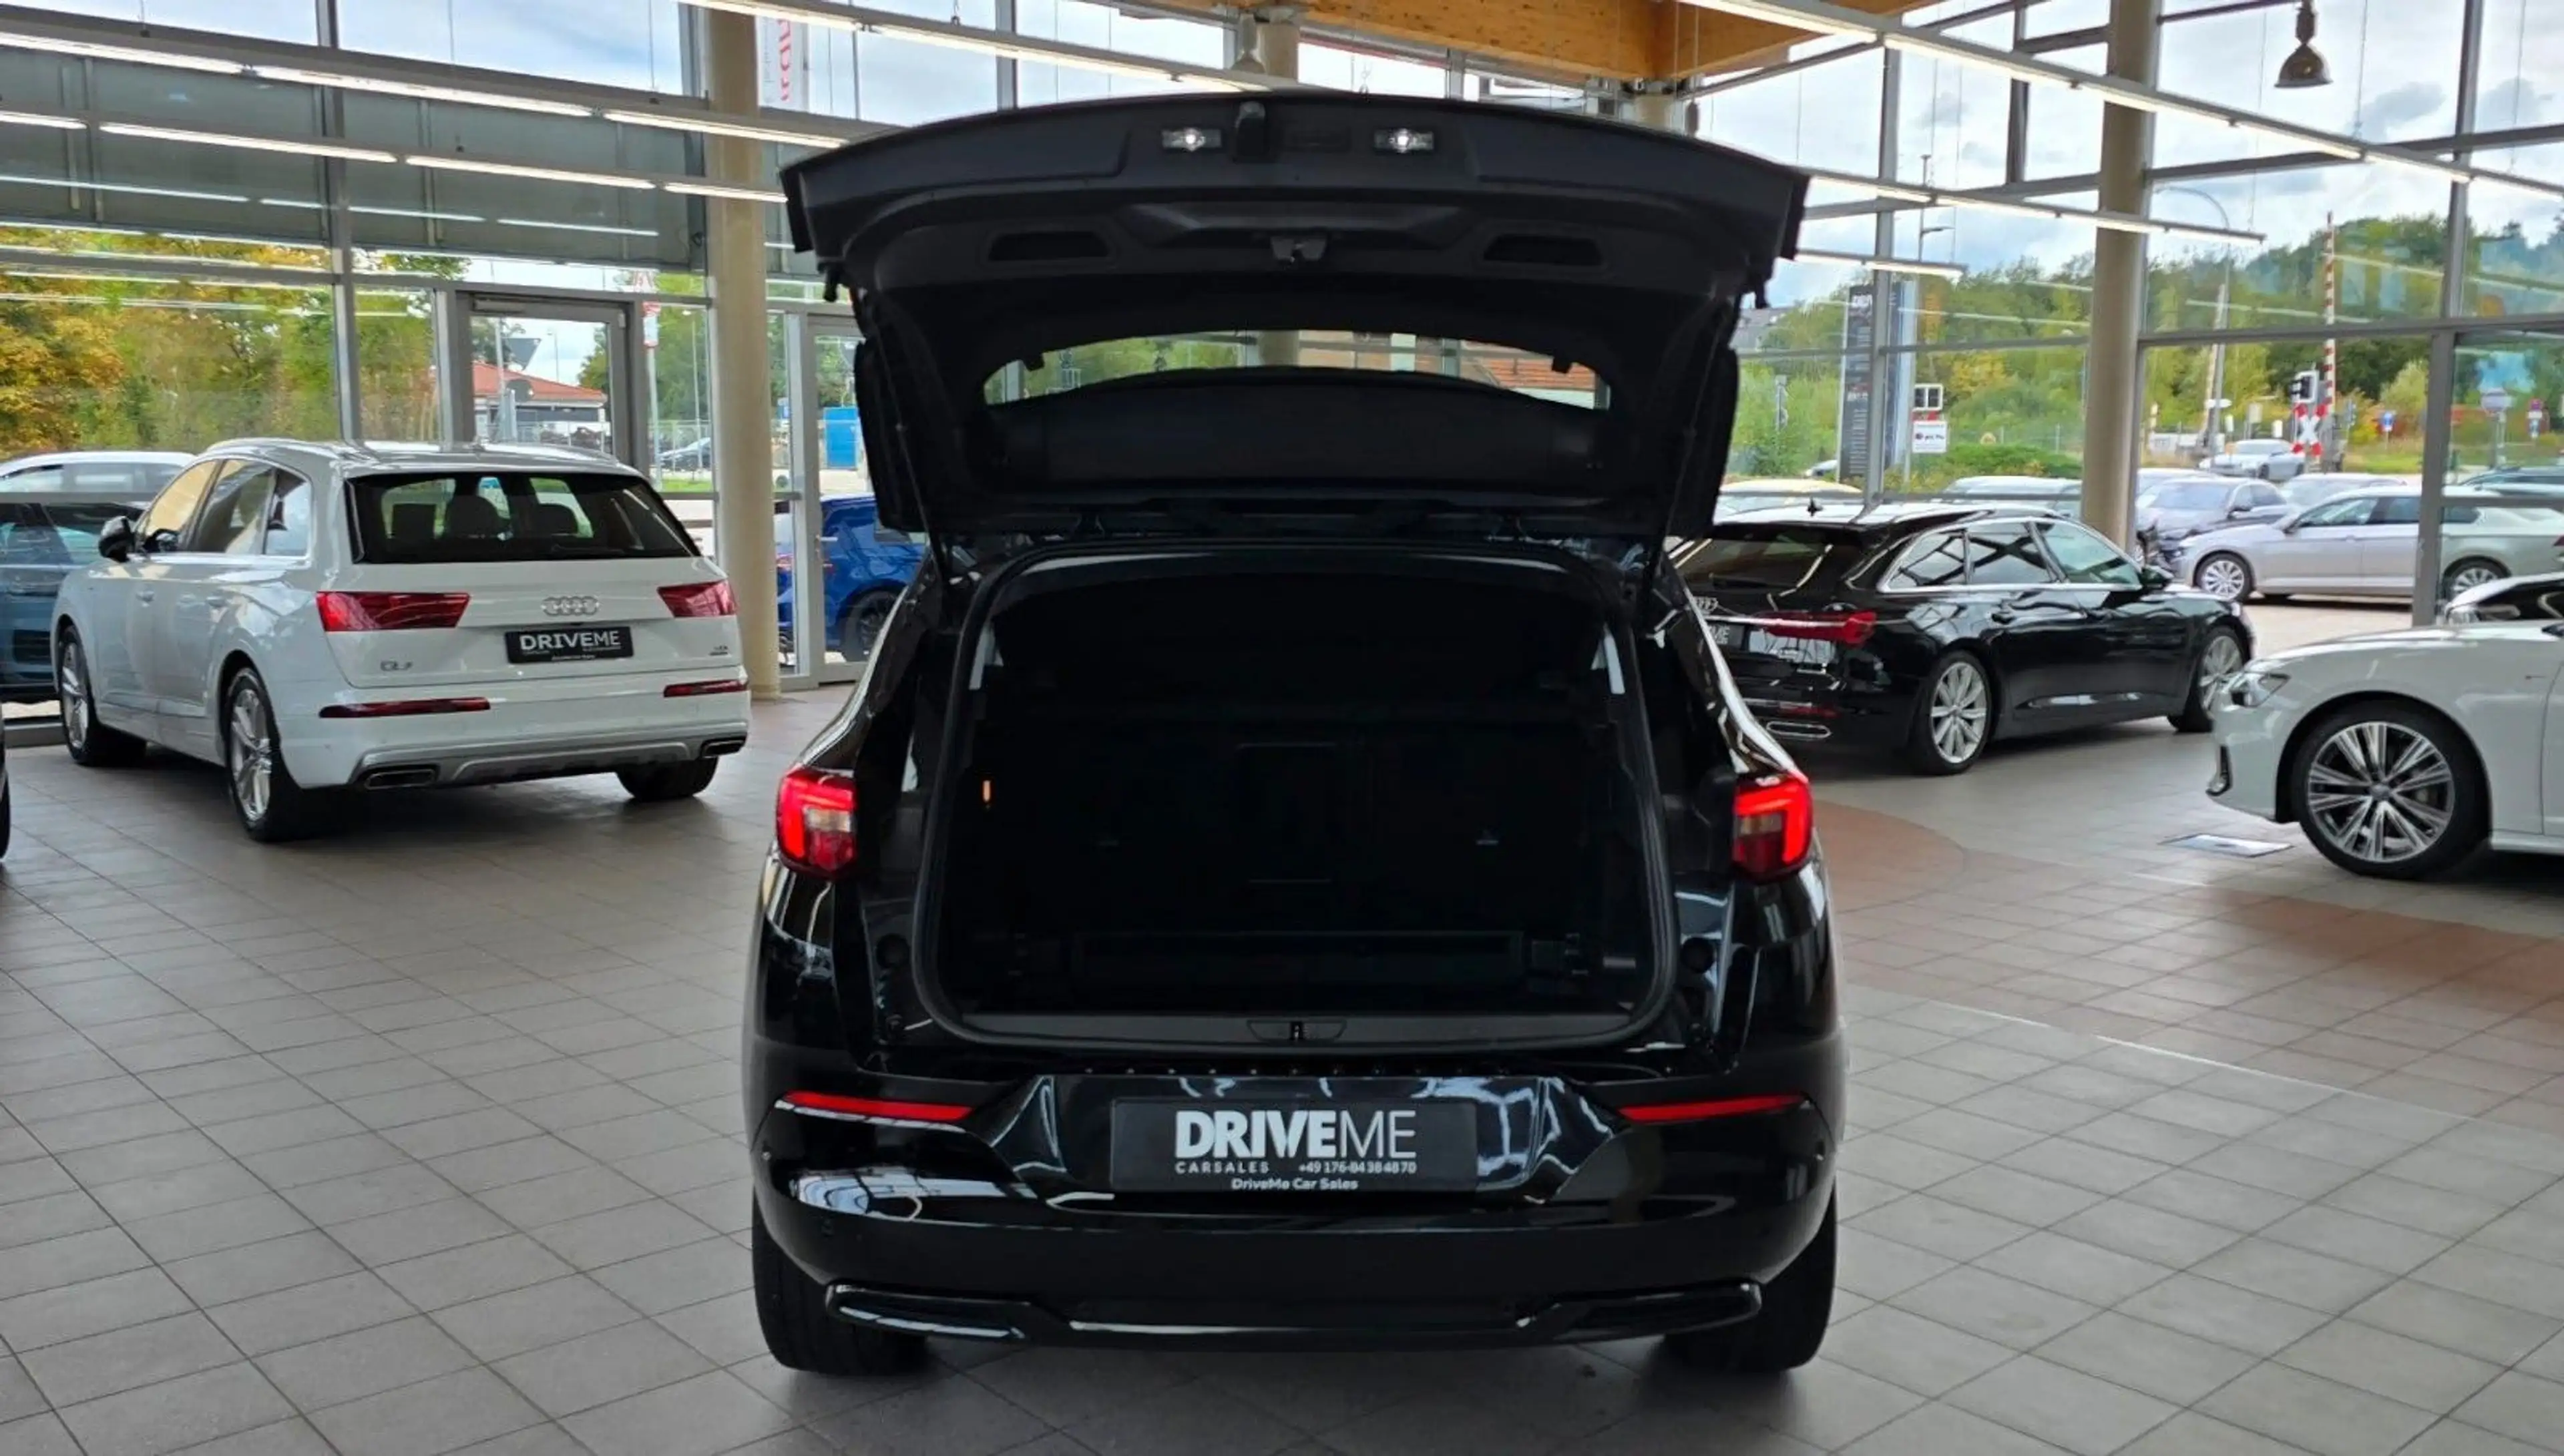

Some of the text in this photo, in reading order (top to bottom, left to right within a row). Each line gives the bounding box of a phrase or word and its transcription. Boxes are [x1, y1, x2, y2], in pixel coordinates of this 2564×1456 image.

[519, 630, 622, 650] DRIVEME
[1175, 1110, 1416, 1158] DRIVEME
[1175, 1162, 1269, 1174] CARSALES
[1231, 1178, 1359, 1190] DriveMe Car Sales
